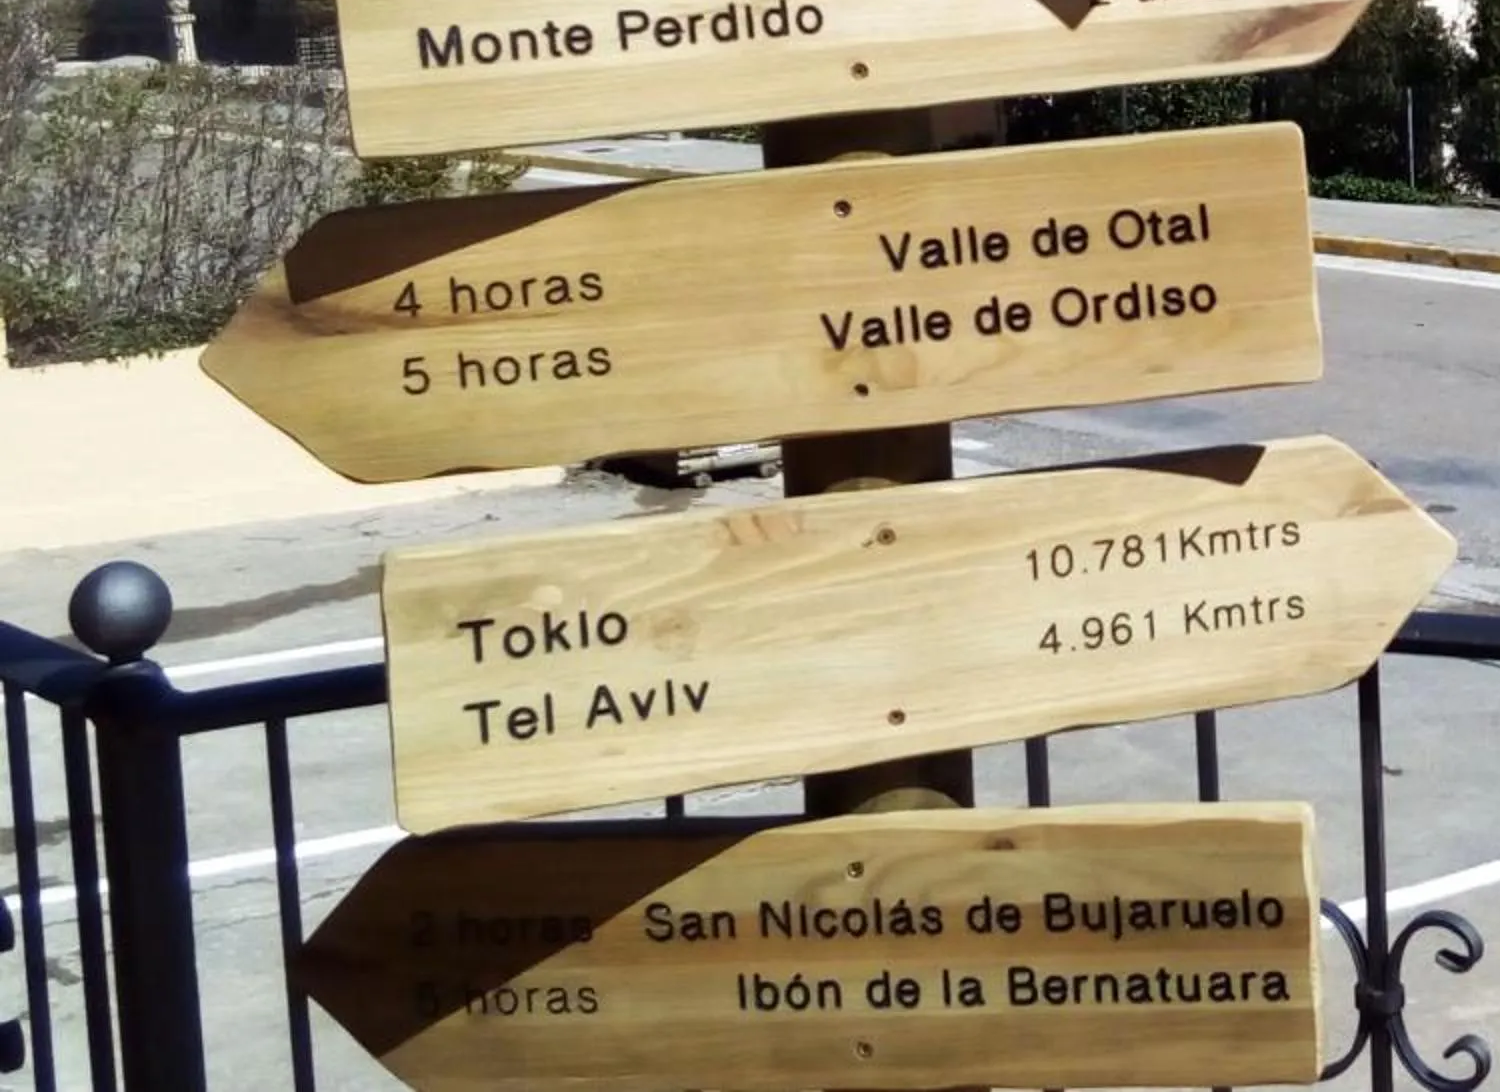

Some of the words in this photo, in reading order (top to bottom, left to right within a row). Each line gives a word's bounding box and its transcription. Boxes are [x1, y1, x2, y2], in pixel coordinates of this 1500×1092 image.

[416, 20, 594, 70] Monte
[878, 225, 1011, 273] Valle
[1031, 217, 1090, 259] de
[1107, 202, 1210, 251] Otal
[393, 280, 423, 320] 4
[449, 272, 604, 315] horas
[819, 303, 953, 353] Valle
[973, 295, 1033, 337] de
[1050, 281, 1218, 329] Ordiso
[402, 356, 432, 396] 5
[457, 346, 612, 390] horas
[455, 609, 629, 665] Tokio
[1038, 609, 1155, 655] 4.961
[1183, 594, 1306, 635] Kmtrs
[461, 692, 556, 746] Tel
[585, 678, 710, 730] Aviv
[457, 907, 592, 946] horas
[644, 902, 736, 943] San
[759, 897, 944, 939] Nicolás
[966, 895, 1022, 935] de
[1044, 888, 1284, 940] Bujaruelo
[465, 980, 600, 1016] horas
[737, 972, 843, 1012] Ibón
[865, 969, 921, 1010] de
[942, 968, 986, 1008] la
[1007, 965, 1291, 1007] Bernatuara
